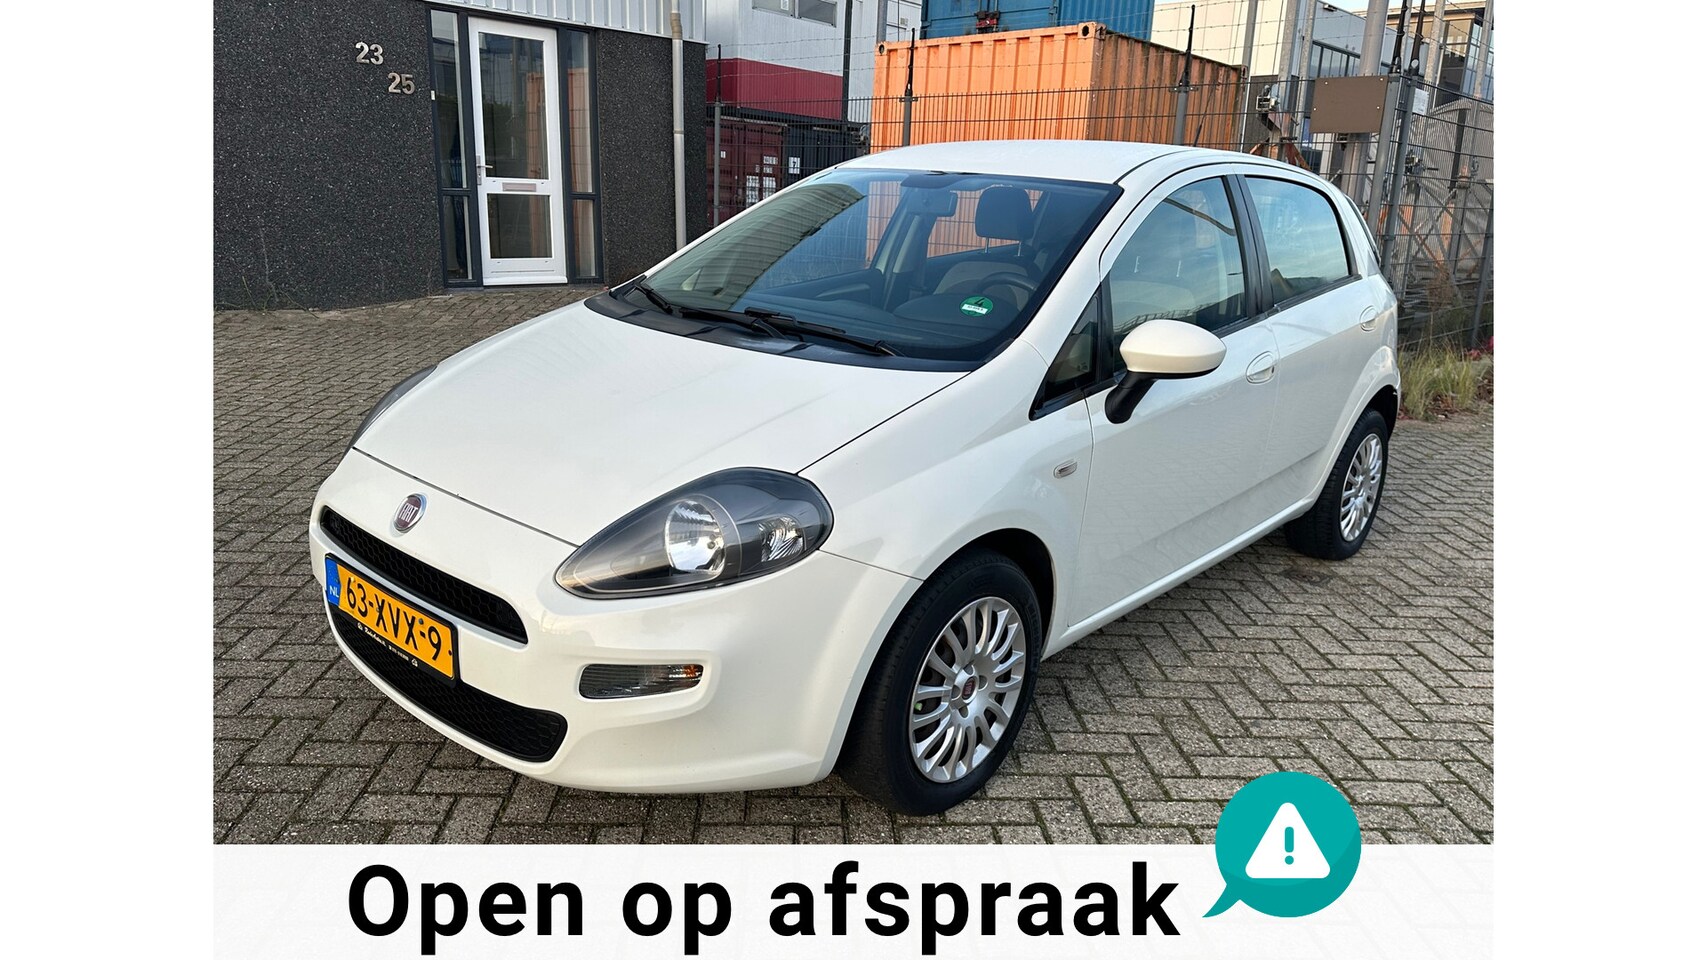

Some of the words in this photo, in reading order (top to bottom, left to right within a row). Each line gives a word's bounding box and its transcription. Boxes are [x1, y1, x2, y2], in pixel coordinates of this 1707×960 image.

[355, 41, 384, 65] 23
[388, 72, 415, 95] 25
[398, 502, 419, 523] FIAT
[329, 585, 339, 599] NL
[346, 577, 443, 661] 63-XVX-9
